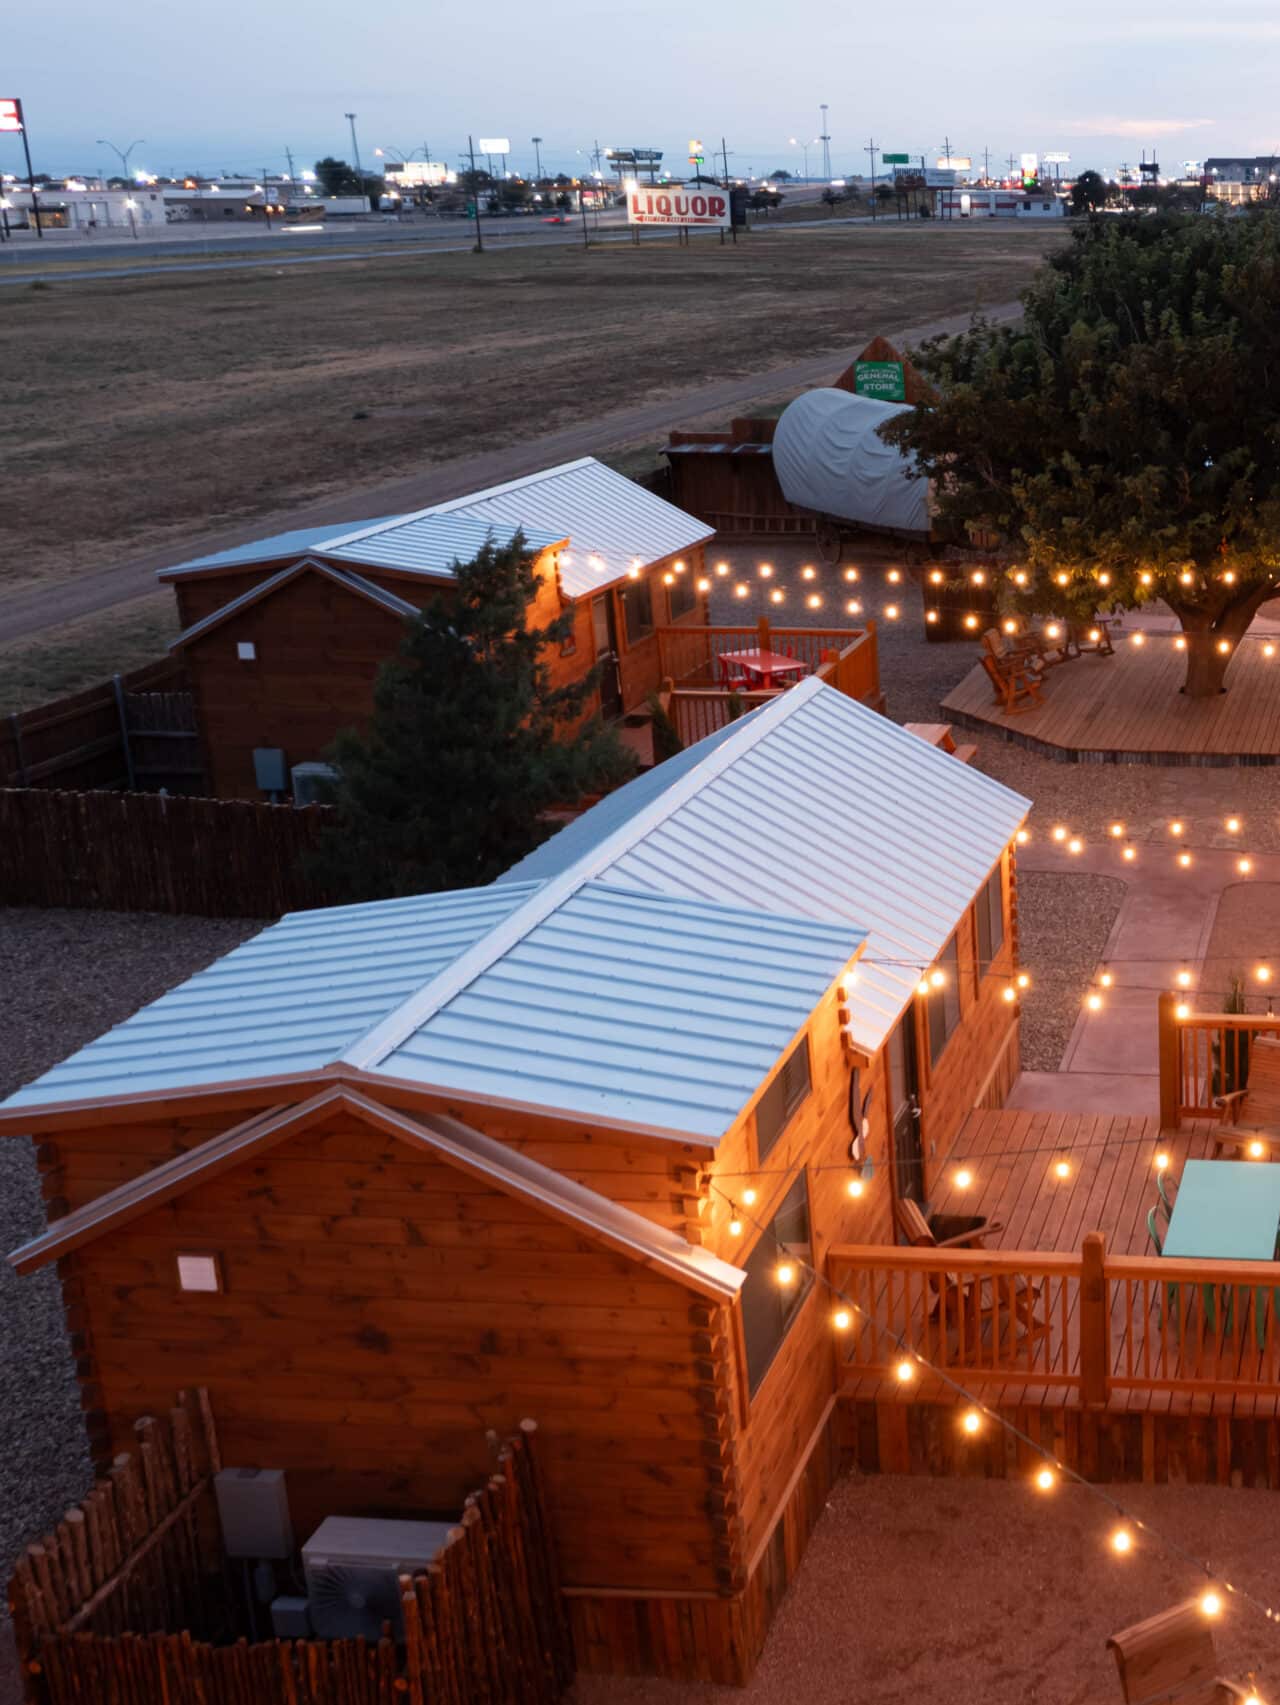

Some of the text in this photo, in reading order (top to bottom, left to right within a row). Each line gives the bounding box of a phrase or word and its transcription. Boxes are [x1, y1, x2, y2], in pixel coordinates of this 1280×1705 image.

[633, 195, 725, 216] LIQUOR
[857, 372, 899, 382] GENERAL
[864, 383, 896, 391] STORE
